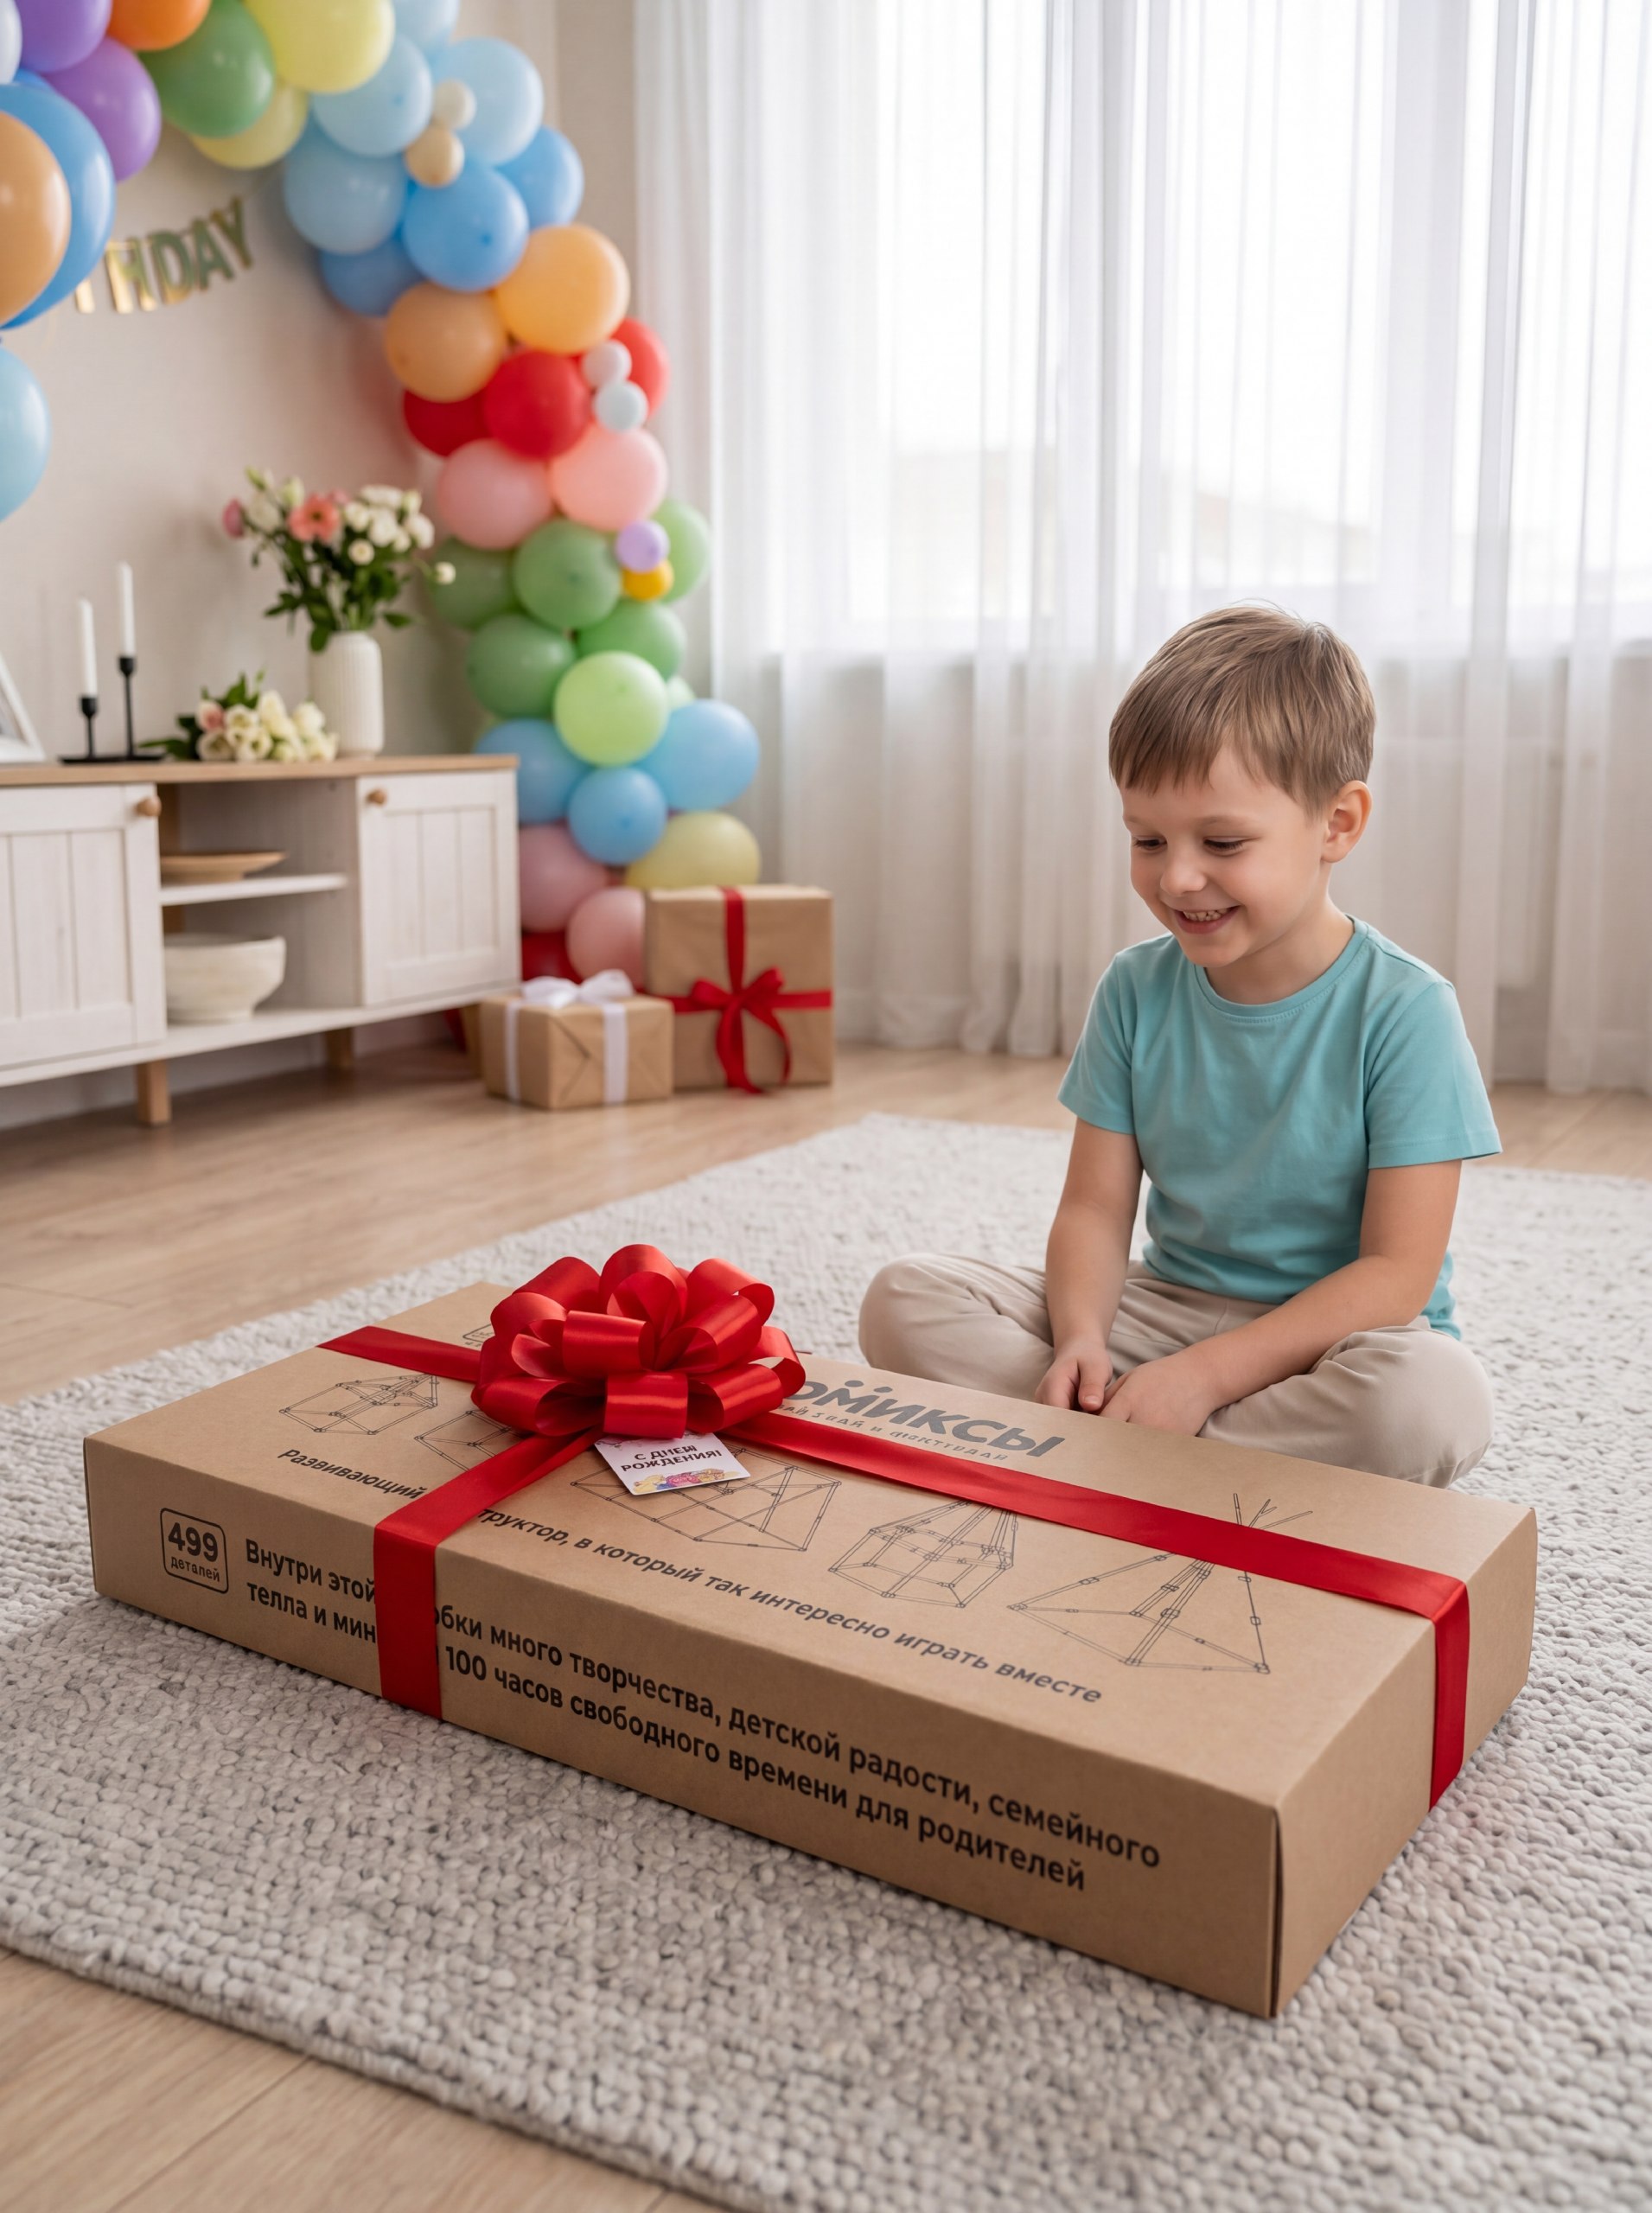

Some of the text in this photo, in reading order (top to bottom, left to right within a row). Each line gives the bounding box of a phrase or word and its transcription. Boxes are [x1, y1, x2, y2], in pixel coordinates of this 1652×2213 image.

[168, 1521, 219, 1563] 499
[277, 1449, 1102, 1703] Развивающий труктор, в который так интересно играть вместе
[246, 1538, 322, 1586] Внутри
[328, 1572, 375, 1604] этой
[490, 1625, 563, 1667] много
[570, 1652, 722, 1727] творчества,
[729, 1706, 840, 1762] детской
[850, 1746, 979, 1814] радости,
[989, 1793, 1161, 1869] семейного
[247, 1581, 308, 1619] телла
[314, 1605, 327, 1626] и
[445, 1645, 488, 1681] 100
[494, 1666, 564, 1708] часов
[570, 1694, 720, 1763] свободного
[729, 1749, 848, 1808] времени
[856, 1794, 909, 1831] для
[919, 1814, 1086, 1891] родителей
